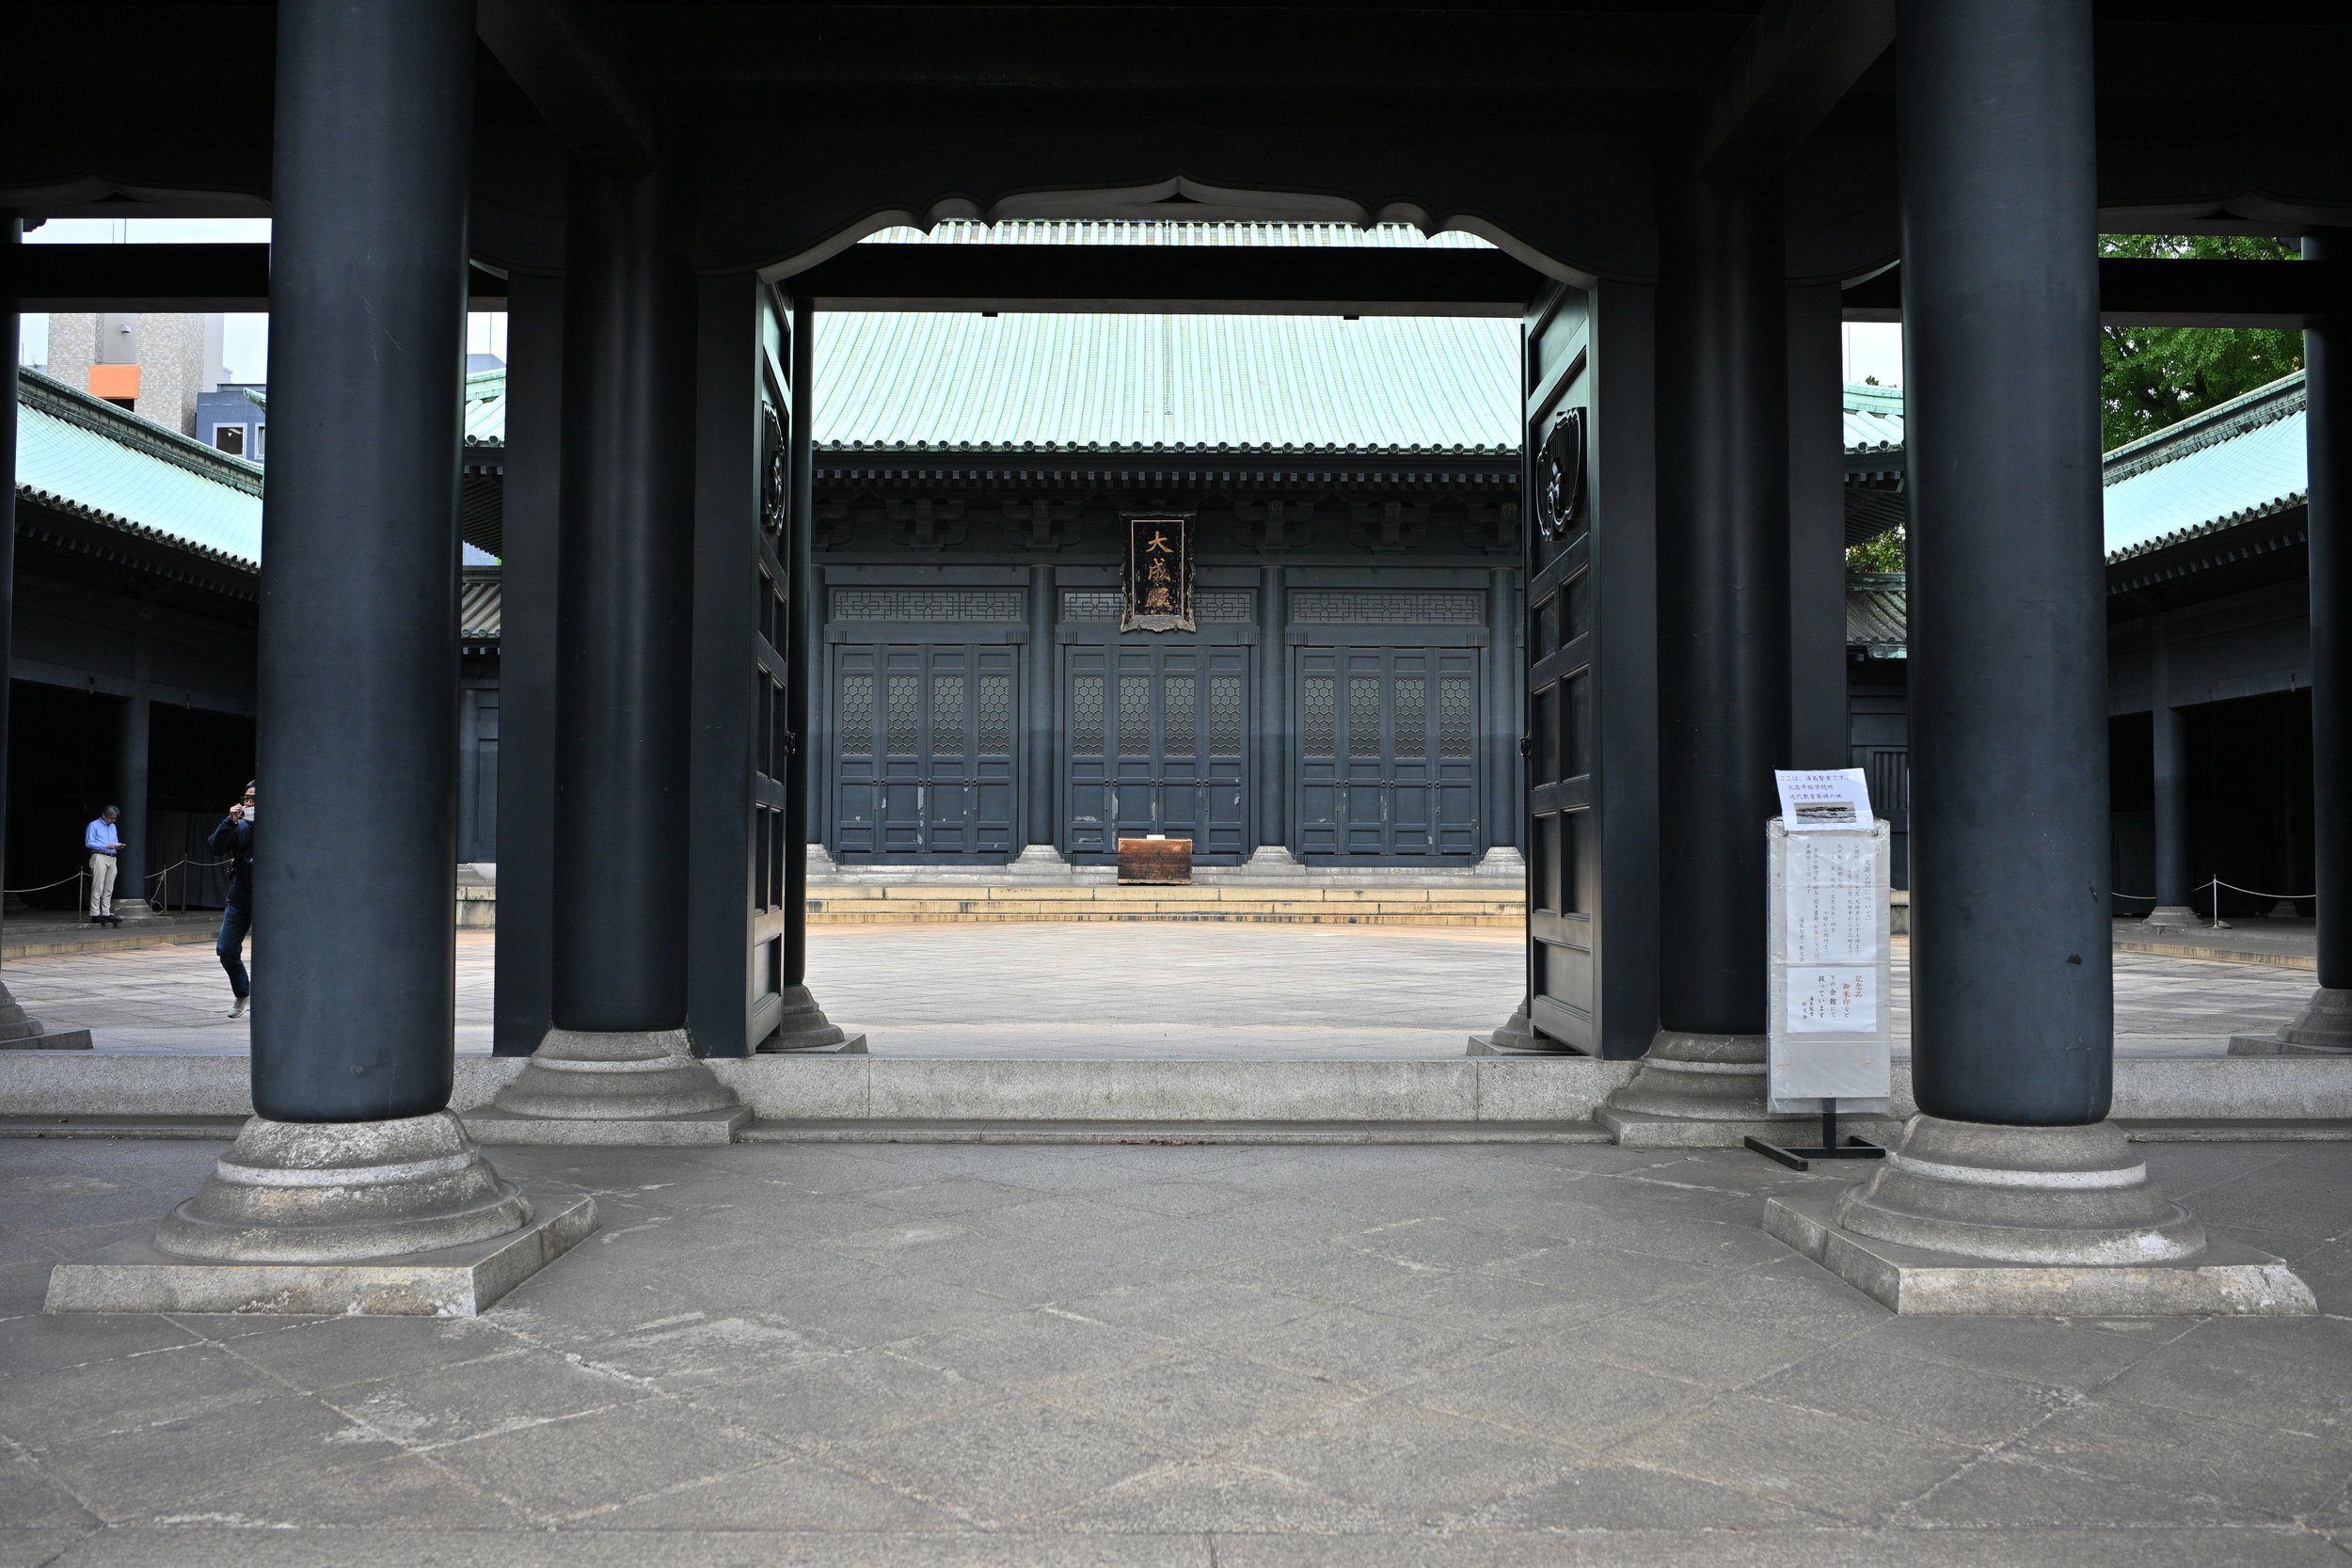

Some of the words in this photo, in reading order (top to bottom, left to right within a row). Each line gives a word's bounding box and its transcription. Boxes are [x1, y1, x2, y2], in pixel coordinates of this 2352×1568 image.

[1818, 974, 1826, 1019] 扱っています
[1854, 974, 1863, 998] 記念品
